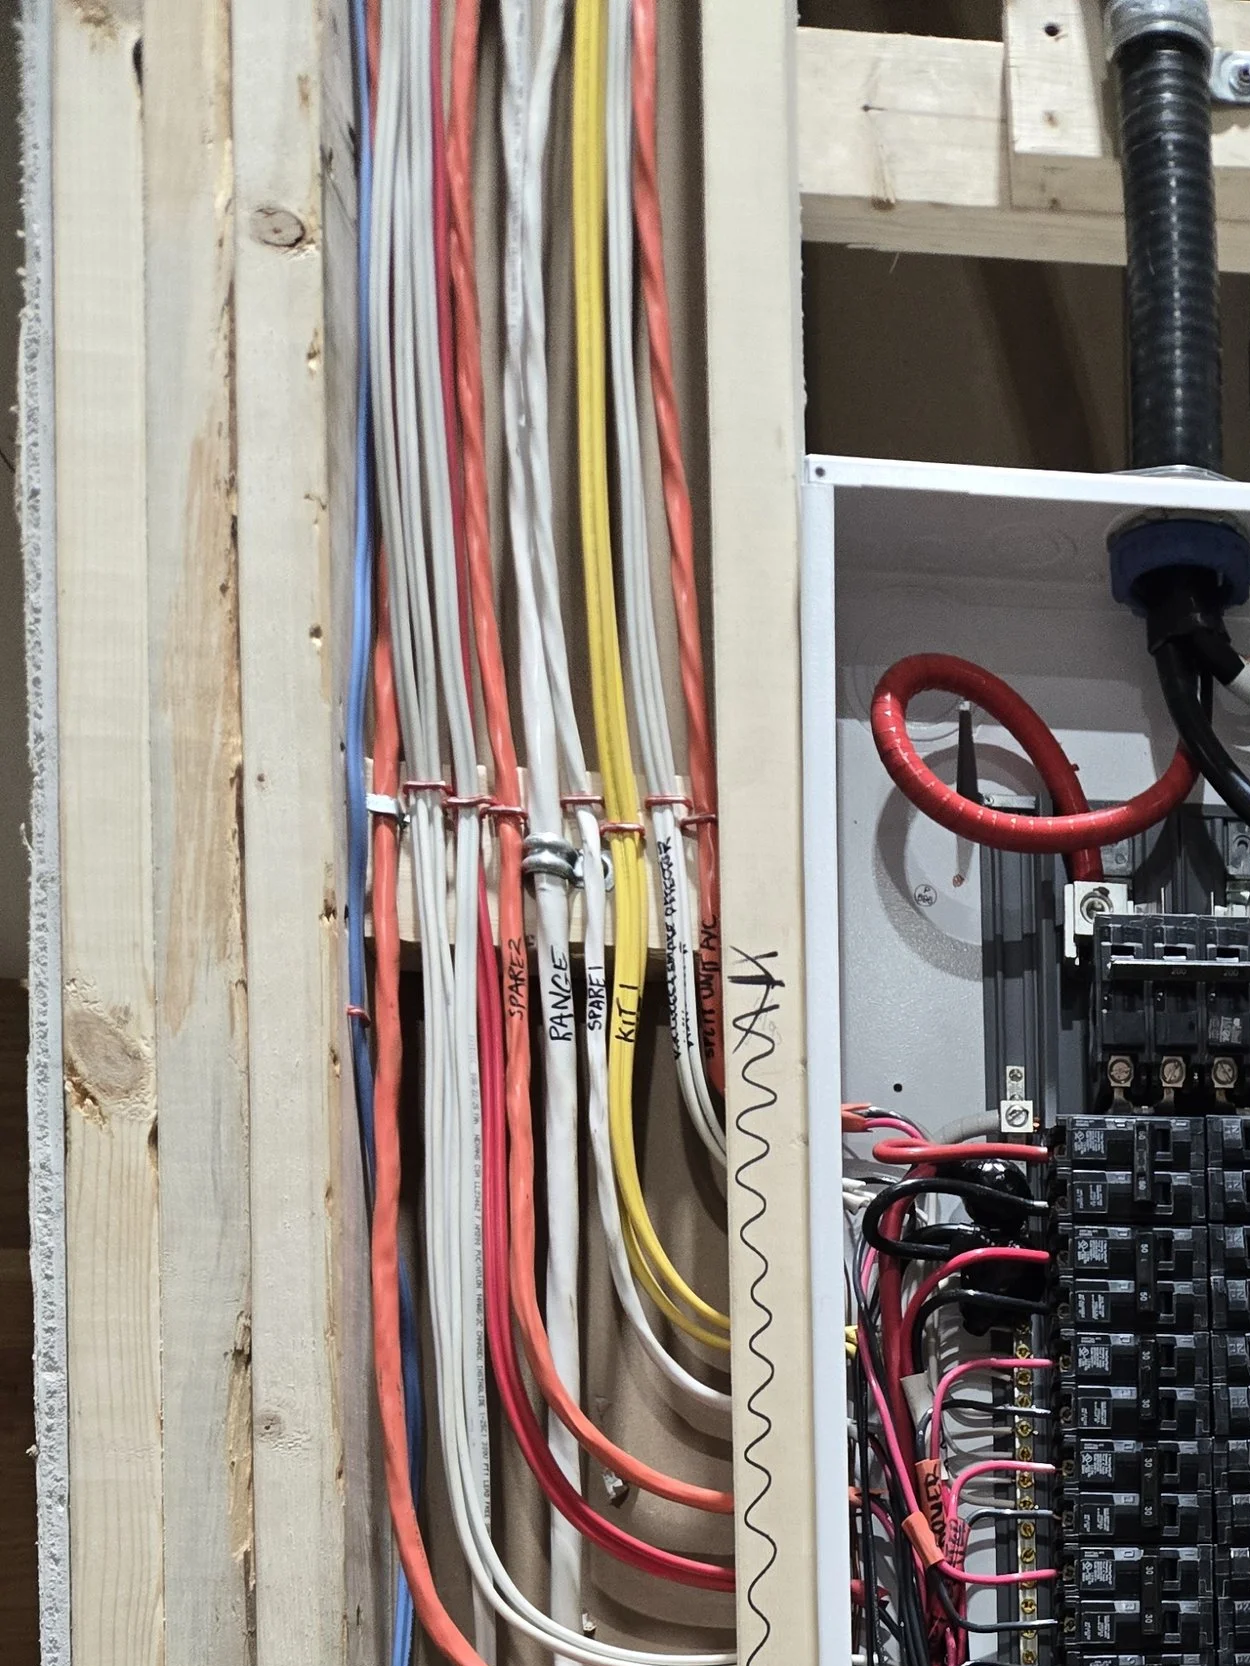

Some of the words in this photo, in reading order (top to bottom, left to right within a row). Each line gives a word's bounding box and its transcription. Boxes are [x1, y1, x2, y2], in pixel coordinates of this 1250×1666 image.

[548, 944, 574, 1042] RANGE
[587, 973, 607, 1031] SPARE
[614, 996, 637, 1043] KIT
